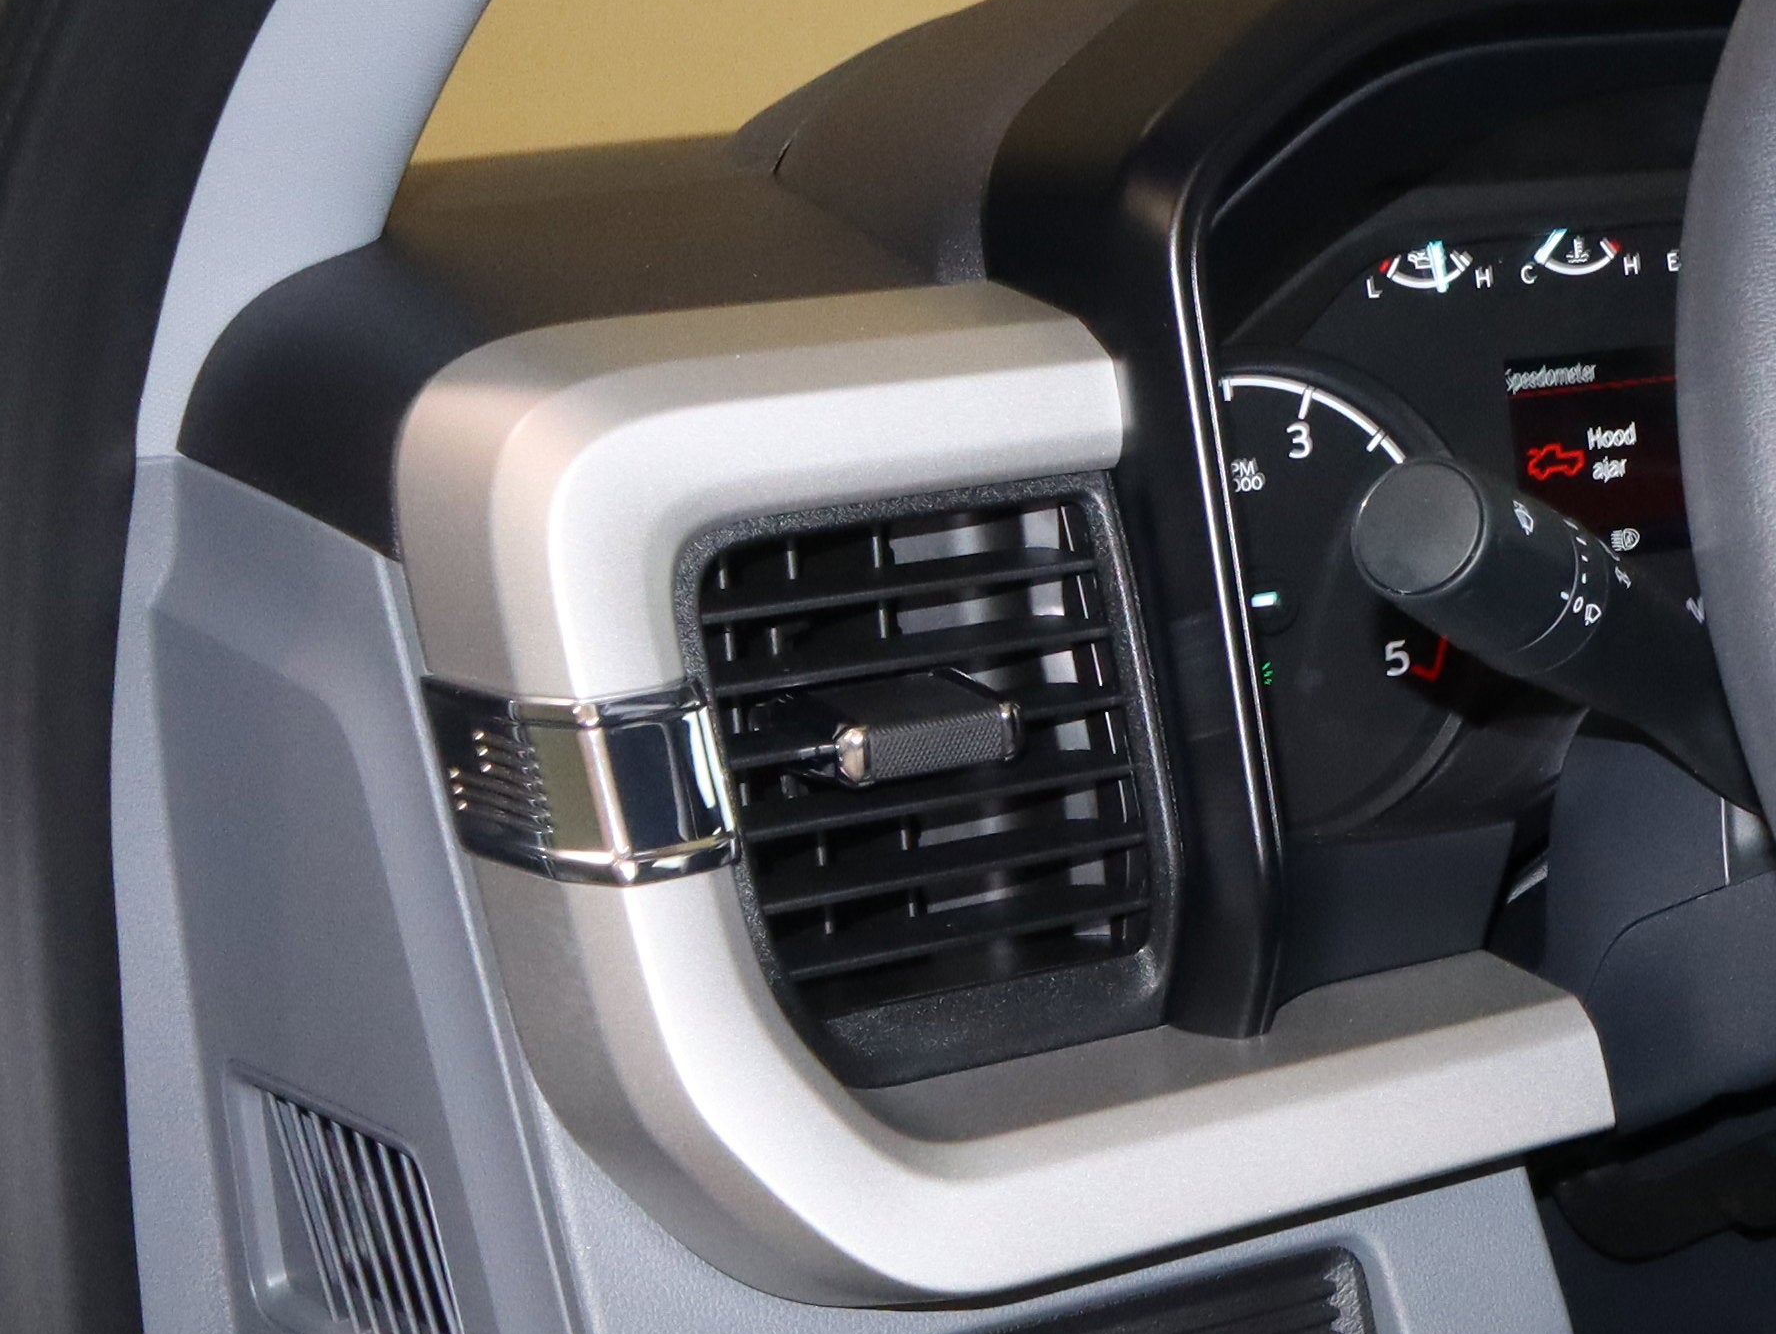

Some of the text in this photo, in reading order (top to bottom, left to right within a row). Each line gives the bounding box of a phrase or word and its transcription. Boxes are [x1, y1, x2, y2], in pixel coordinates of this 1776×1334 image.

[1623, 252, 1641, 276] H
[1666, 249, 1681, 272] E
[1366, 275, 1382, 299] L
[1474, 265, 1493, 289] H
[1520, 265, 1537, 285] C
[1286, 421, 1313, 459] 3
[1587, 421, 1638, 450] Hood
[1592, 456, 1628, 483] ajar
[1385, 640, 1411, 677] 5
